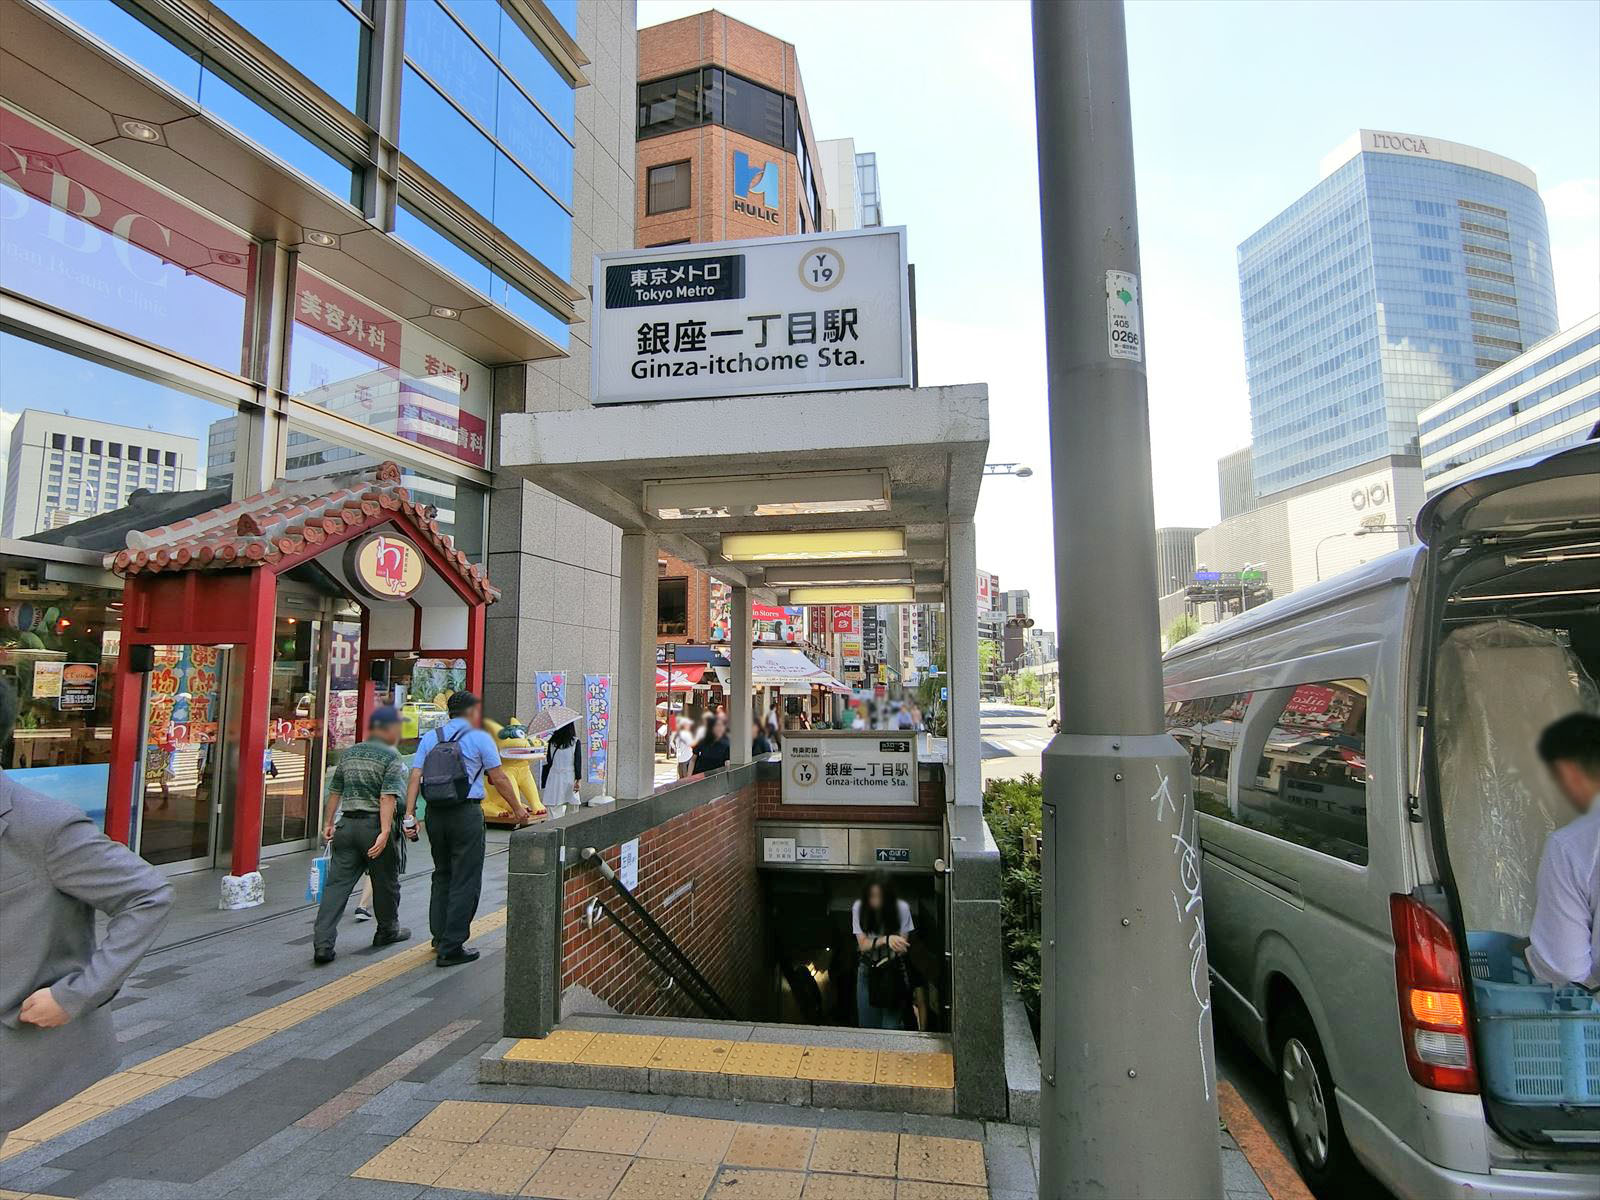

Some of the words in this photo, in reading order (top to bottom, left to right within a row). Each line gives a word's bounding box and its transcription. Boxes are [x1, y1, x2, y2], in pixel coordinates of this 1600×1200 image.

[734, 200, 779, 225] HULIC
[815, 254, 827, 266] Y
[630, 263, 721, 287] 東京メトロ
[812, 268, 833, 283] 19
[636, 287, 673, 303] Tokyo
[676, 285, 715, 299] Metro
[300, 289, 386, 353] 美容外科
[1113, 319, 1130, 328] 405
[637, 308, 859, 356] 銀座一丁目駅
[1112, 329, 1139, 345] 0266
[631, 352, 809, 380] Ginza-itchome
[818, 346, 865, 368] Sta.
[899, 742, 905, 751] 3
[802, 764, 808, 772] Y
[825, 762, 909, 777] 銀座一丁目駅
[800, 773, 812, 781] 19
[825, 777, 889, 786] Ginza-itchome
[891, 777, 908, 786] Sta.
